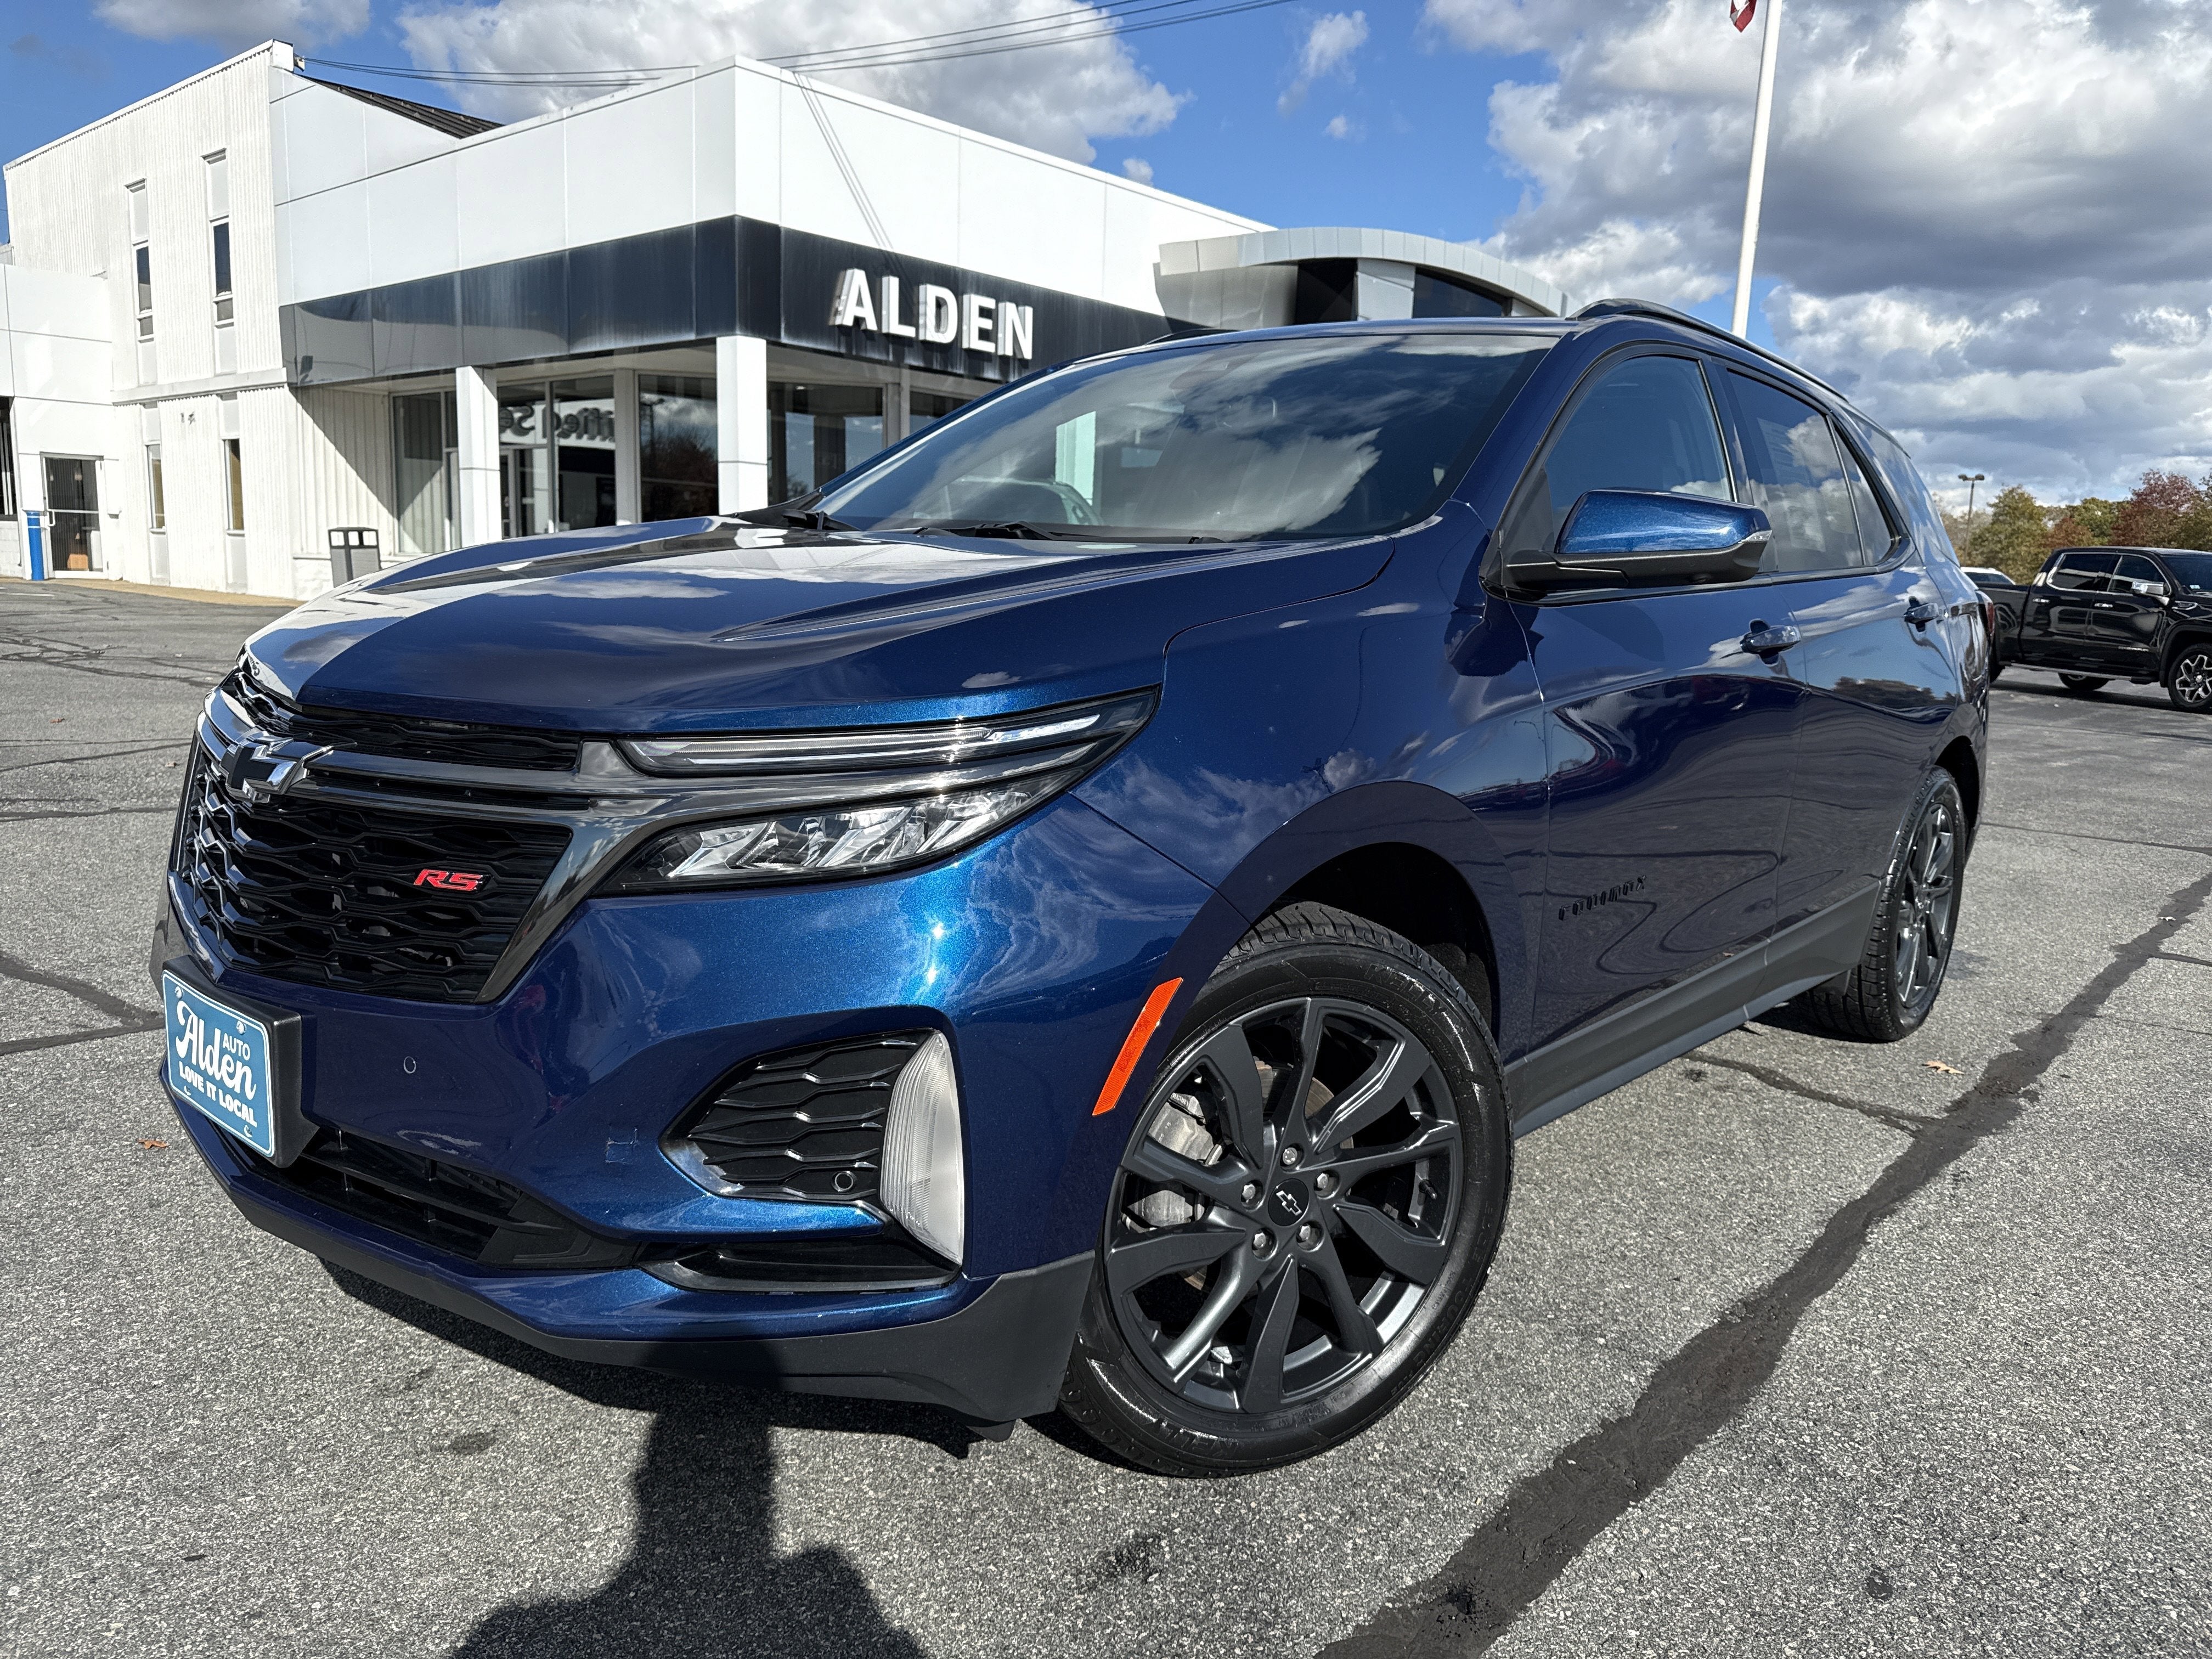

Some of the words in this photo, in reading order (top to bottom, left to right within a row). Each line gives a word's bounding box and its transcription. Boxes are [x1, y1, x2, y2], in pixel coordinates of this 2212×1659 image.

[831, 267, 1034, 360] ALDEN
[414, 869, 483, 891] RS
[176, 1000, 257, 1101] Alden
[222, 1032, 251, 1061] AUTO
[179, 1060, 205, 1093] LOVE
[206, 1080, 217, 1102] IT
[218, 1088, 257, 1128] LOCAL
